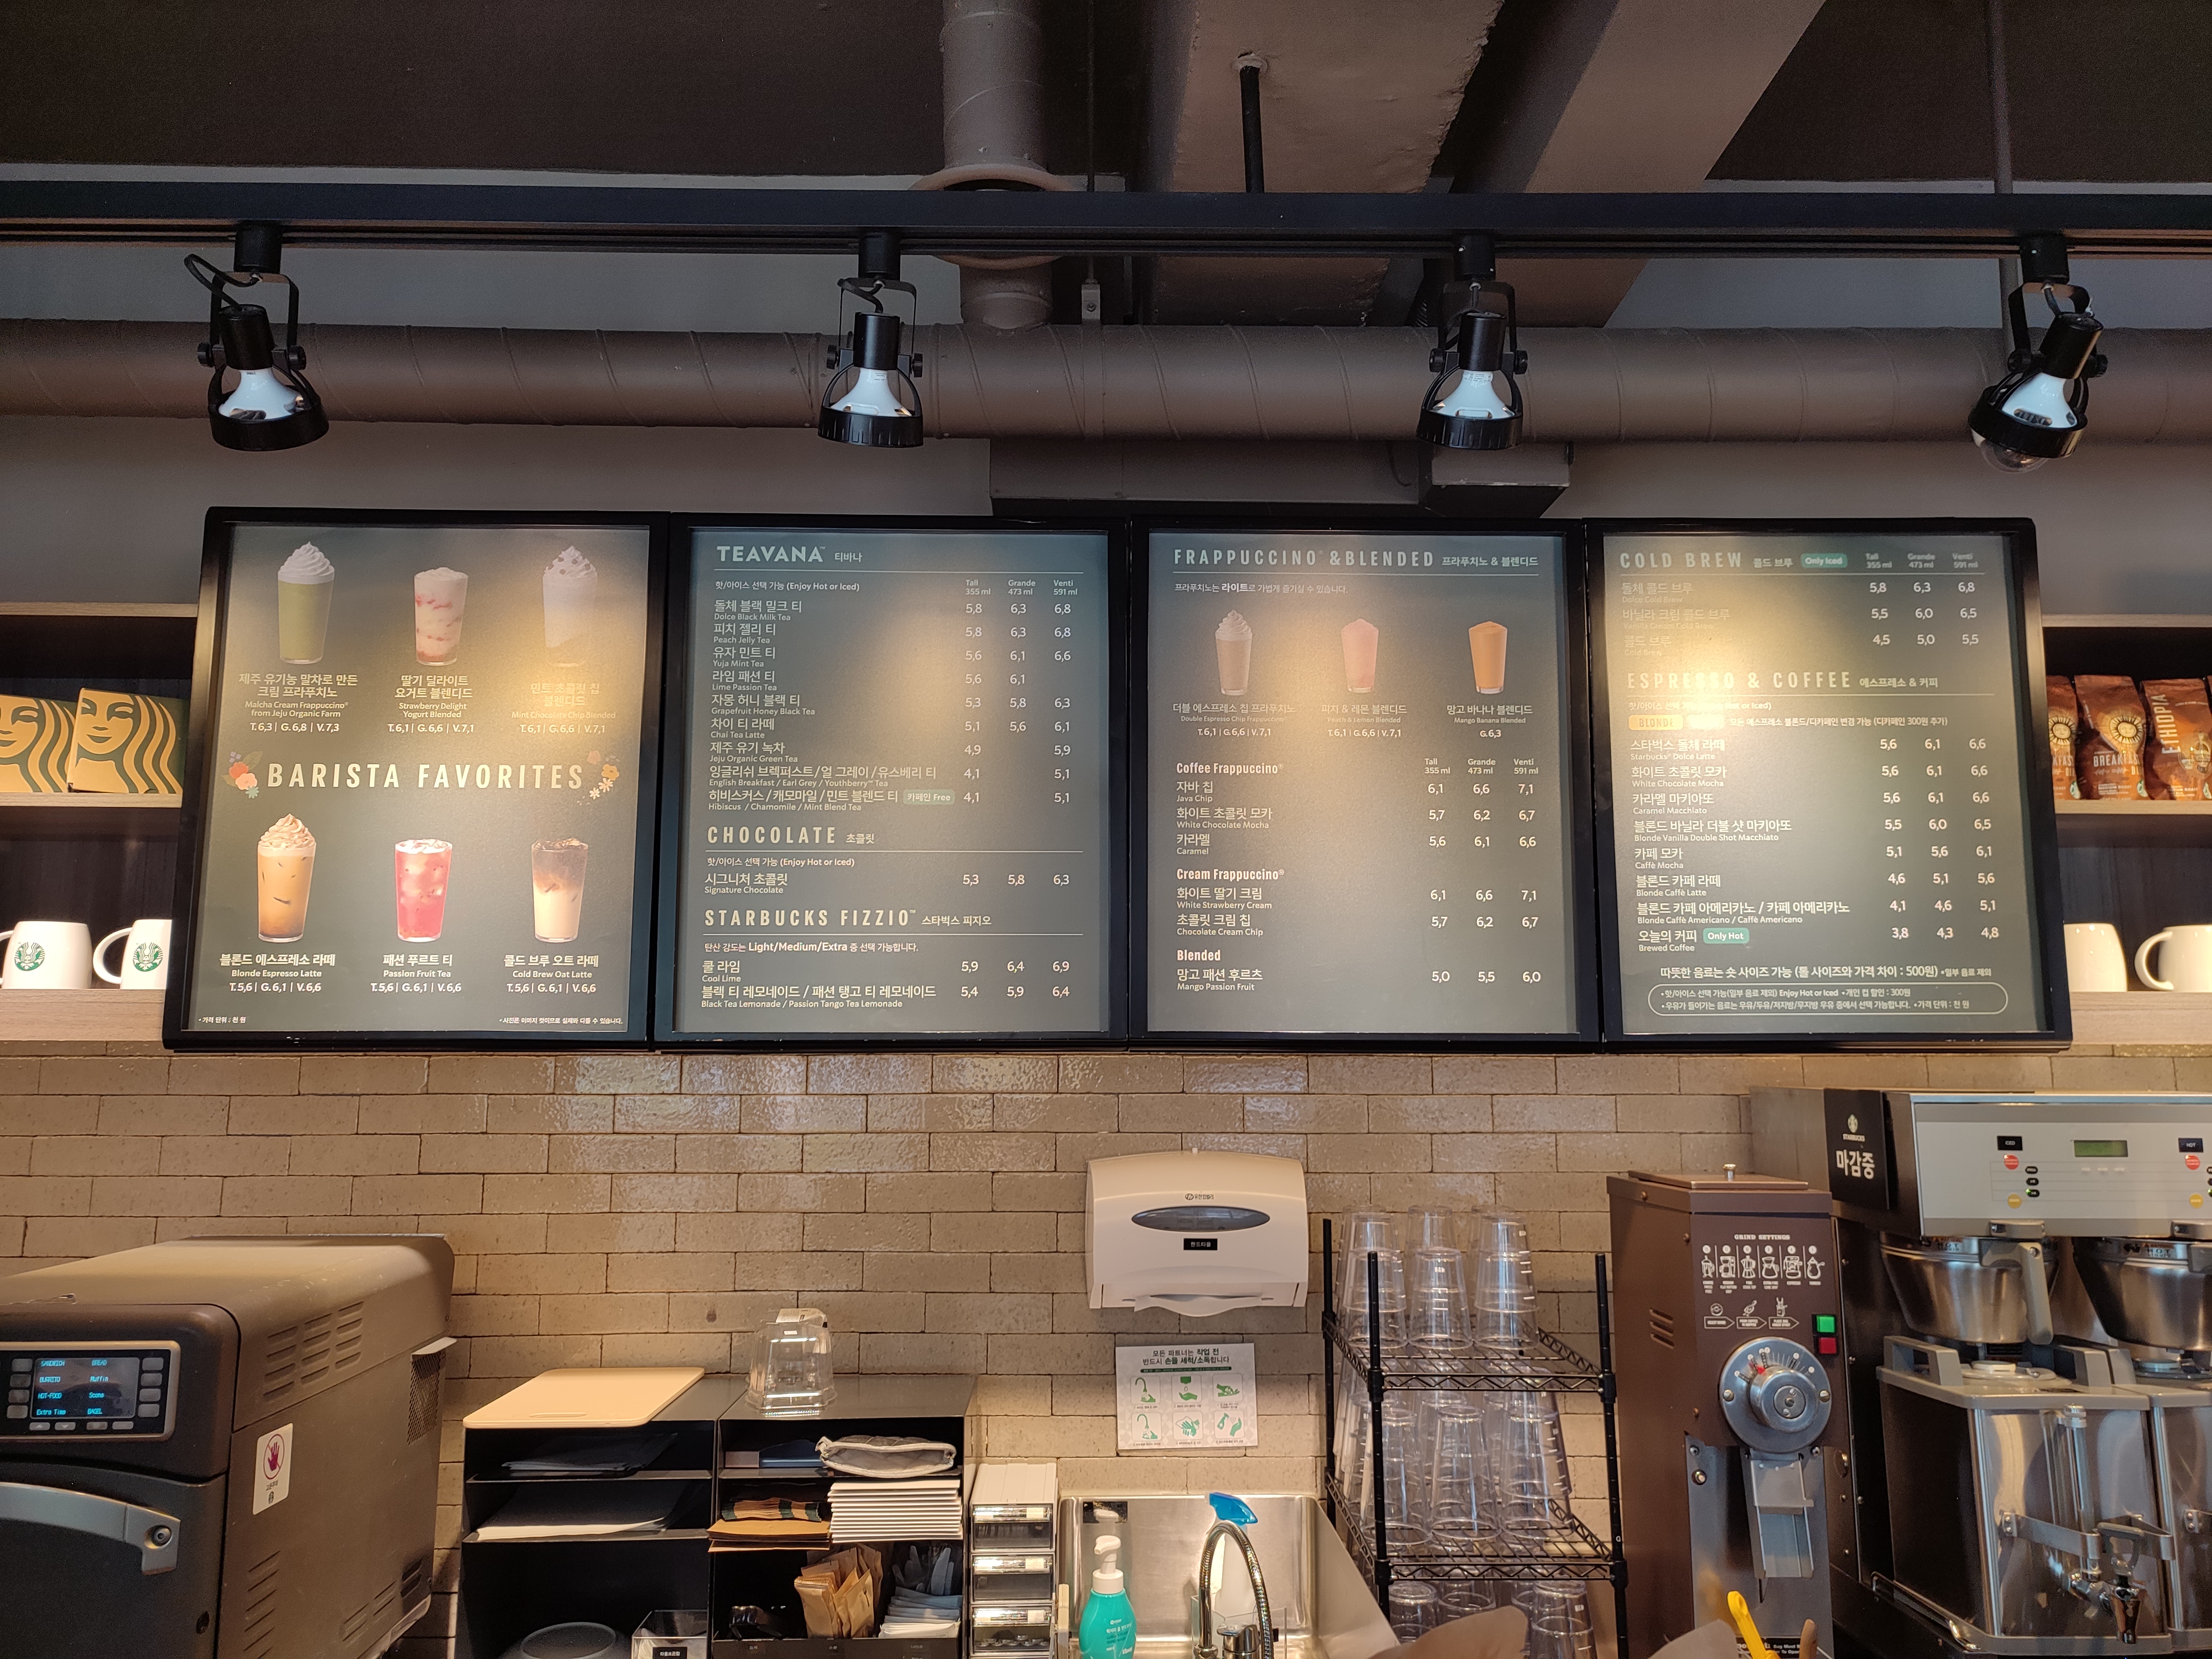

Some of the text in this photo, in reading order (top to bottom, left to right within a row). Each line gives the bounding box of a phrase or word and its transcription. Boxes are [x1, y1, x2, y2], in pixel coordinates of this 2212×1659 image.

[834, 552, 863, 562] 티바나
[1442, 556, 1489, 567] 프라푸치노
[1490, 556, 1498, 566] &
[1501, 556, 1538, 567] 블렌디드
[1620, 552, 1672, 568] COLD
[1685, 552, 1741, 567] BREW
[1753, 558, 1772, 568] 콜드
[1774, 557, 1793, 568] 브루
[1804, 557, 1824, 566] Only
[1870, 582, 1975, 594] 5,8 6,3 6,8
[714, 599, 802, 614] 돌체 블랙 밀크 티
[966, 603, 1071, 615] 5,8 6,3 6,8
[738, 636, 755, 645] Jelly
[238, 673, 358, 686] 제주 유기농 말차로 만든
[401, 675, 468, 687] 딸기 딜라이트
[1748, 672, 1760, 688] &
[1773, 671, 1850, 688] COFFEE
[1859, 677, 1907, 688] 에스프레소
[1908, 677, 1917, 687] &
[1919, 677, 1938, 688] 커피
[398, 702, 467, 711] Strawberry Delight
[2151, 694, 2181, 754] ETHIOPIA
[2093, 754, 2141, 768] BREAKFAS
[1176, 762, 1211, 774] Coffee
[268, 763, 582, 789] BARISTA FAVORITES
[1176, 781, 1213, 794] 자바 칩
[1194, 794, 1213, 804] Chip
[1632, 792, 1714, 806] 카라멜 마키아또
[707, 826, 874, 844] CHOCOLATE 초콜릿
[1176, 833, 1210, 846] 카라멜
[705, 873, 787, 888] 시그니처 초콜릿
[1177, 868, 1211, 880] Cream
[705, 884, 784, 895] Signature Chocolate
[1202, 901, 1245, 911] Strawberry
[705, 910, 827, 926] STARBUCKS
[921, 915, 961, 927] 스타벅스
[962, 915, 992, 926] 피지오
[1638, 930, 1672, 943] 오늘의
[1674, 930, 1697, 943] 커피
[1707, 932, 1727, 941] Only
[1892, 927, 1999, 940] 3,8 4,3 4,8
[1639, 943, 1695, 952] Brewed Coffee
[220, 953, 336, 967] 블론드 에스프레소 라떼
[1177, 949, 1220, 961] Blended
[702, 960, 740, 973] 쿨 라임
[231, 969, 261, 977] Blonde
[262, 969, 299, 978] Espresso
[1177, 968, 1263, 982] 망고 패션 후르츠
[1432, 971, 1541, 984] 5,0 5,5 6,0
[1836, 1149, 1875, 1180] 마감중
